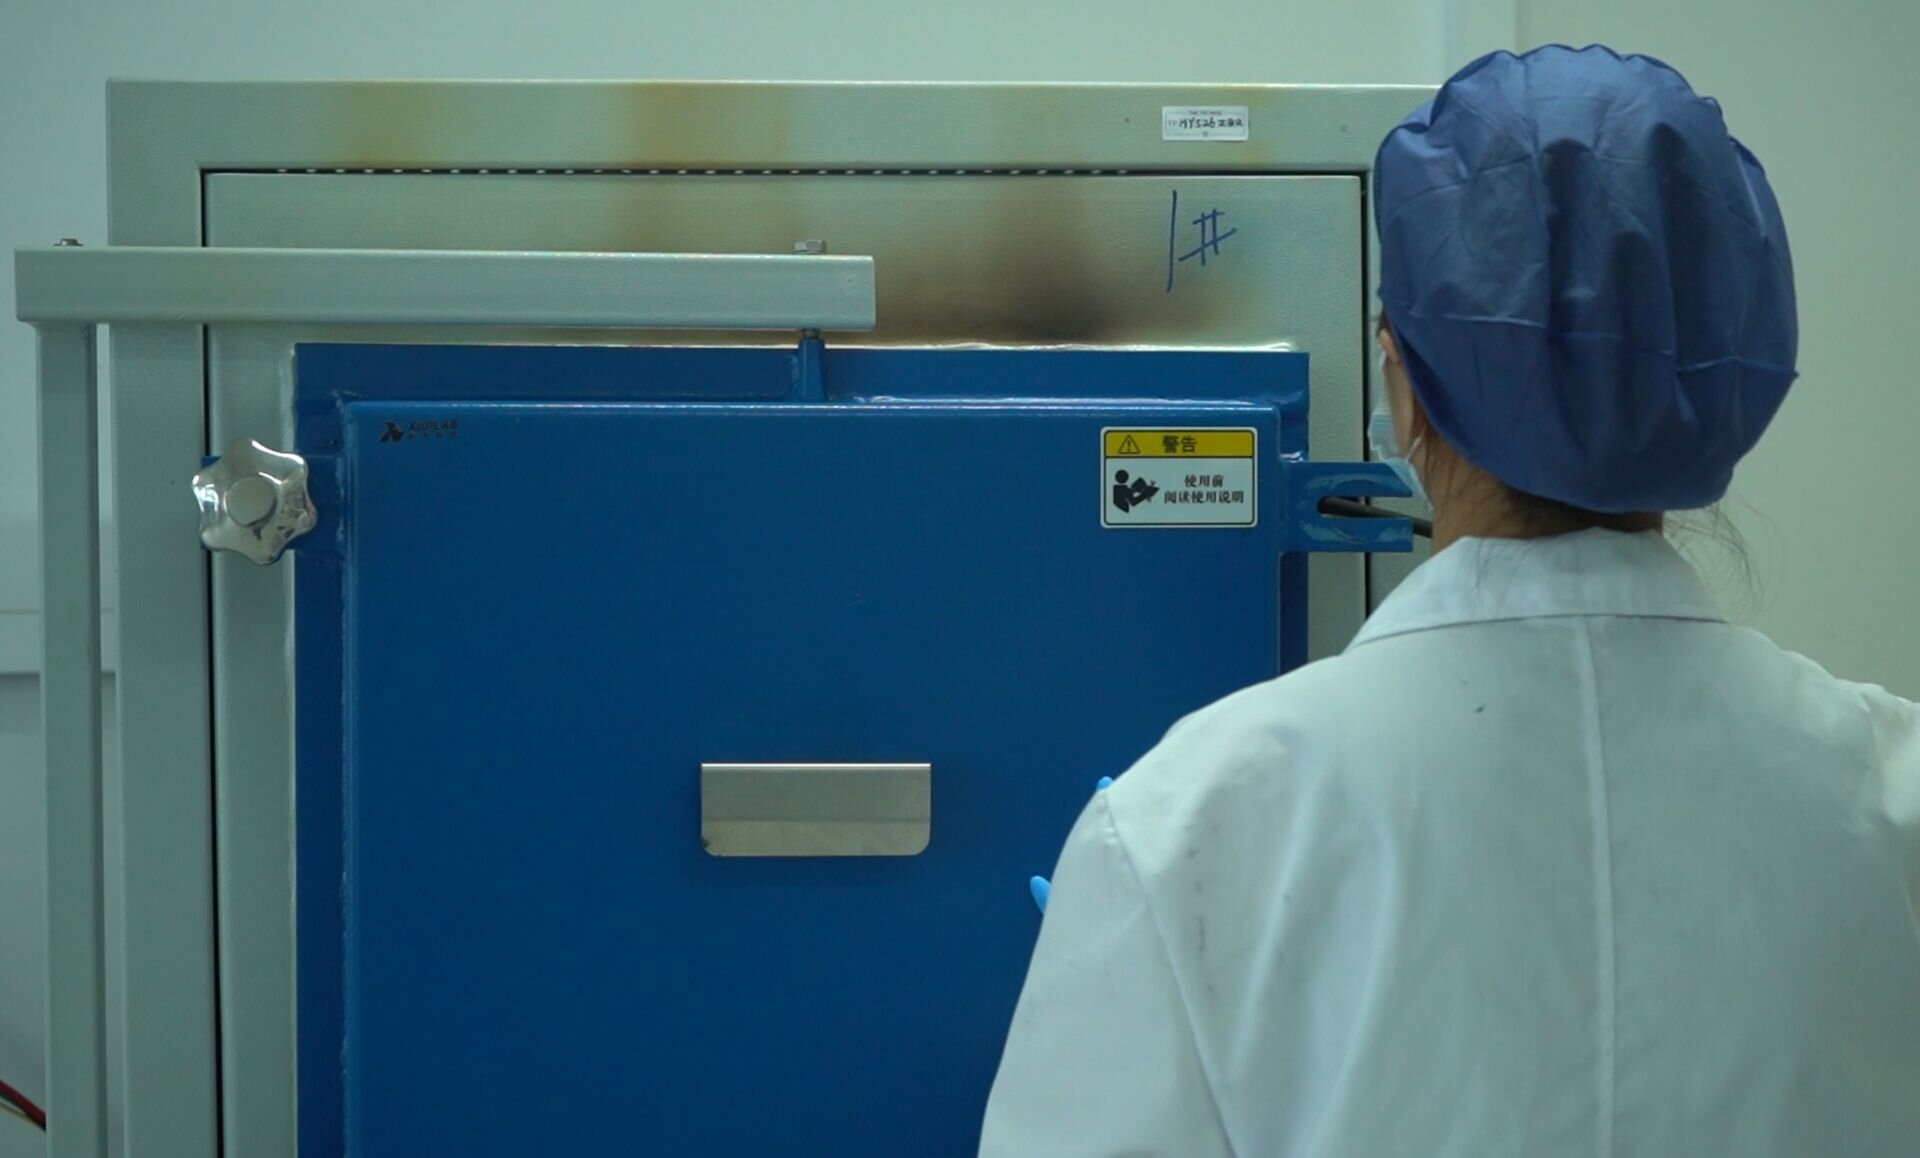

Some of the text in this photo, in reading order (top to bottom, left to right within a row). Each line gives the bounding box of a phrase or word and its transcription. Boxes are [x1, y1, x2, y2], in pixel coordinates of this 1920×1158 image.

[1162, 435, 1197, 453] 警告
[1184, 474, 1224, 488] 使用前
[1164, 490, 1244, 504] 阅读使用说明
